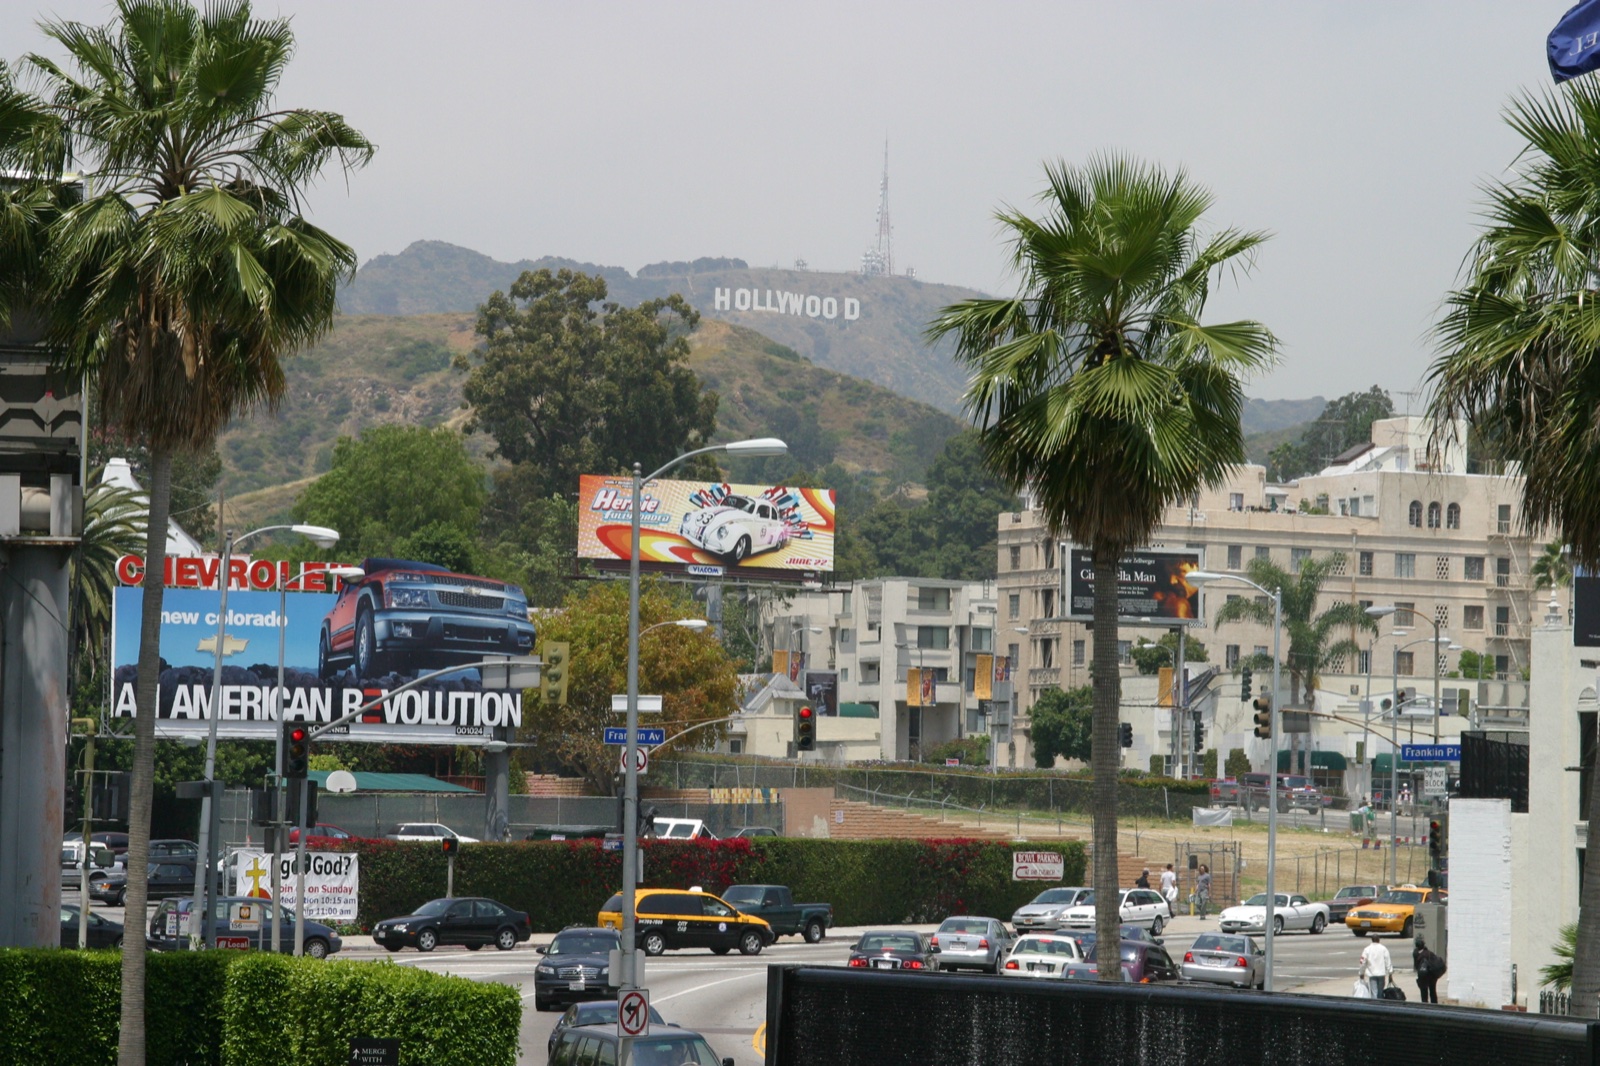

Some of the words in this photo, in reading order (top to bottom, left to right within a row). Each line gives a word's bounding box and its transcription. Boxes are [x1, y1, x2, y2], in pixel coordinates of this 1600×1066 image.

[714, 287, 860, 321] HOLLYWOOD
[592, 489, 659, 513] Herie
[785, 557, 813, 566] JUNE
[692, 566, 719, 574] VIACOM
[1134, 571, 1156, 583] Man
[205, 609, 288, 627] colorado
[115, 682, 160, 719] A
[170, 683, 332, 723] AMERICAN
[342, 687, 521, 728] REVOLUTION
[456, 727, 483, 735] 001024
[648, 732, 661, 740] Av
[1405, 747, 1444, 757] Franklin
[313, 855, 351, 876] God?
[321, 885, 353, 896] Sunday
[316, 907, 338, 915] 11:00
[227, 940, 248, 949] Local
